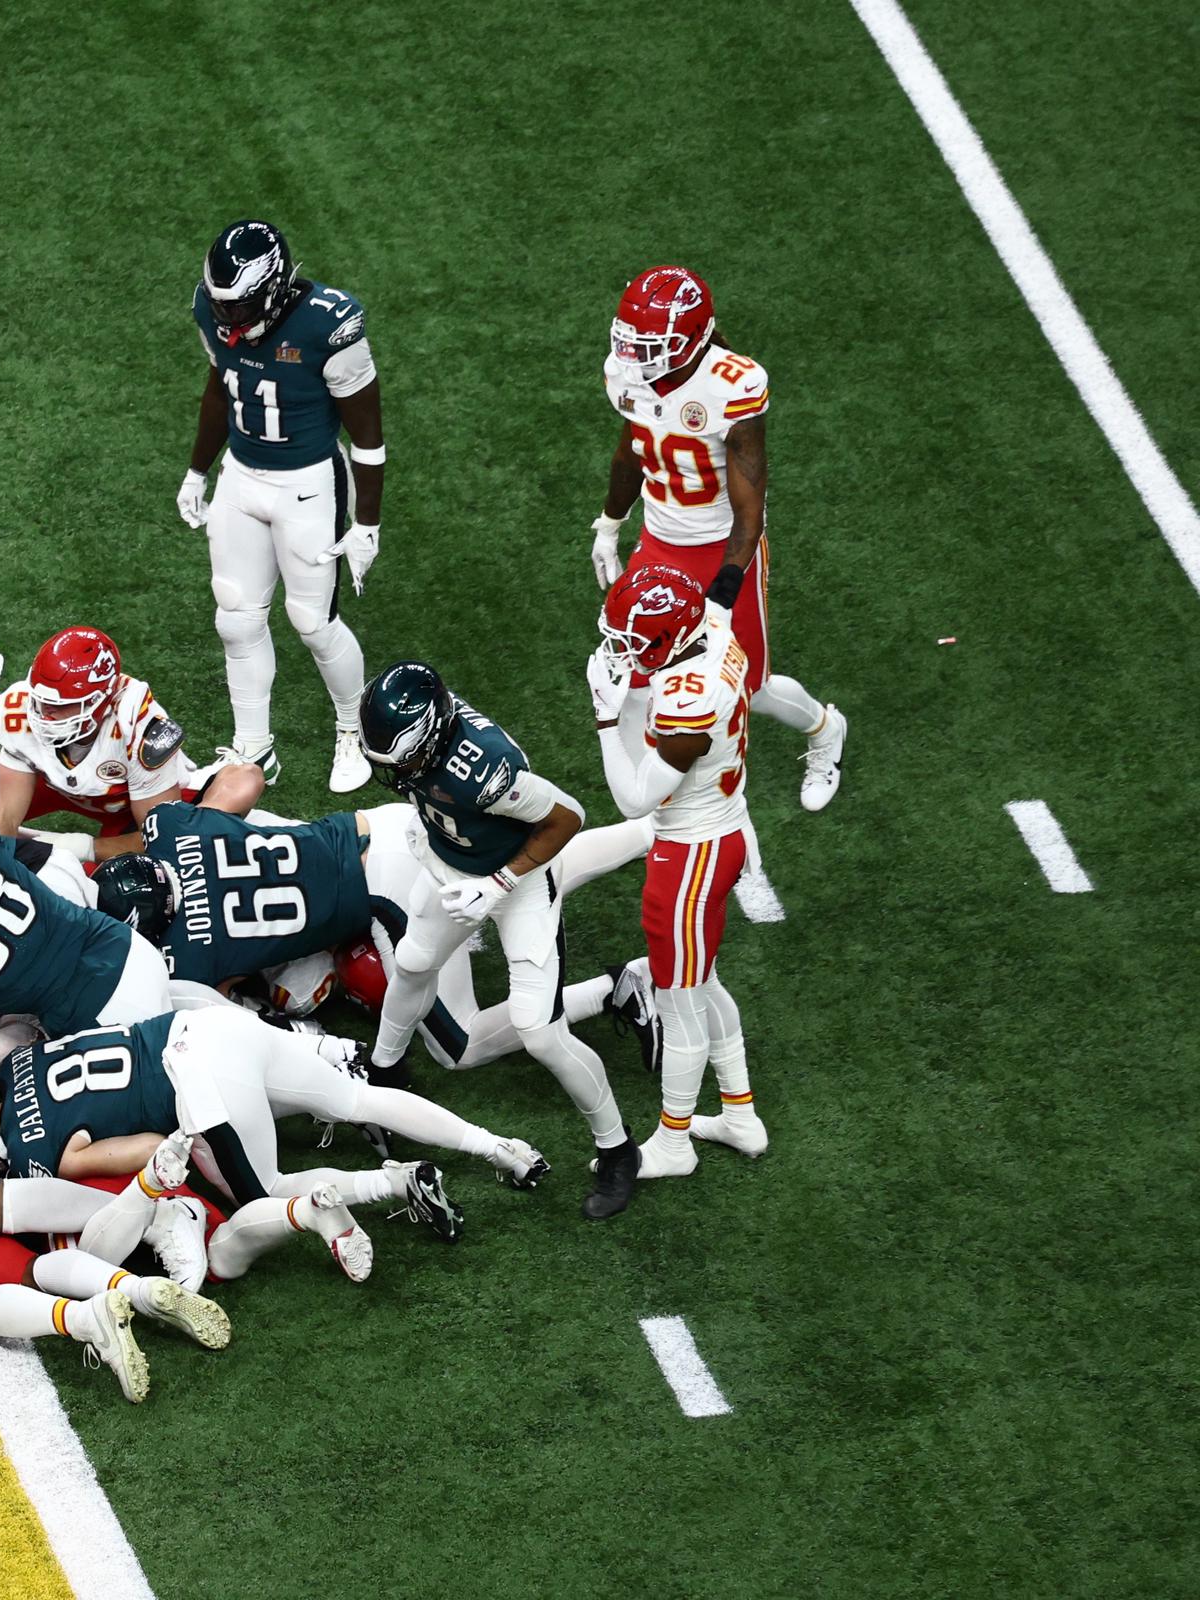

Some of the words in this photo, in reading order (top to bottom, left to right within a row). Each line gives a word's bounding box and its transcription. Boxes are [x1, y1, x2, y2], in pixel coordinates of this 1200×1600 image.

[309, 287, 350, 313] 11
[239, 357, 265, 370] EAGLES
[222, 367, 290, 443] 11
[629, 421, 722, 509] 20
[3, 690, 32, 734] 56
[662, 671, 706, 697] 35
[445, 738, 484, 782] 89
[174, 834, 213, 946] JOHNSON
[213, 833, 308, 938] 65
[12, 1044, 47, 1144] CALCATER
[43, 1023, 134, 1103] 81
